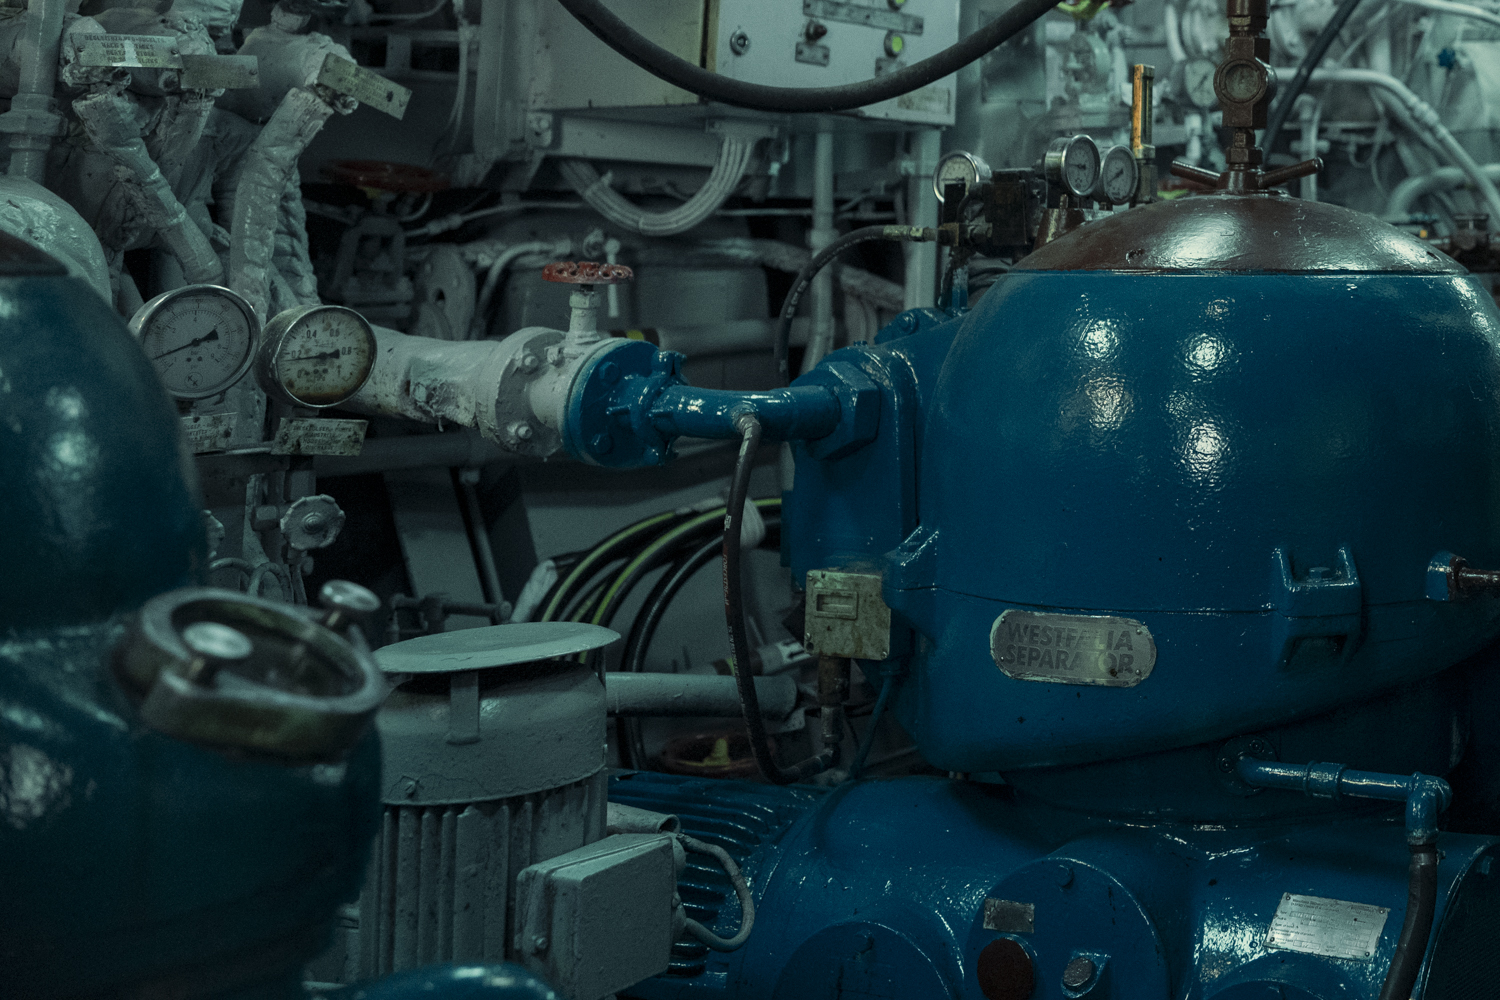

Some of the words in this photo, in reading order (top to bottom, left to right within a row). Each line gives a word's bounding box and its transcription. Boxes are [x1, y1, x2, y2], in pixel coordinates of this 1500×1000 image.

[306, 329, 317, 339] 0.4
[341, 346, 352, 355] 0.8
[1005, 644, 1134, 674] SEPARAOR
